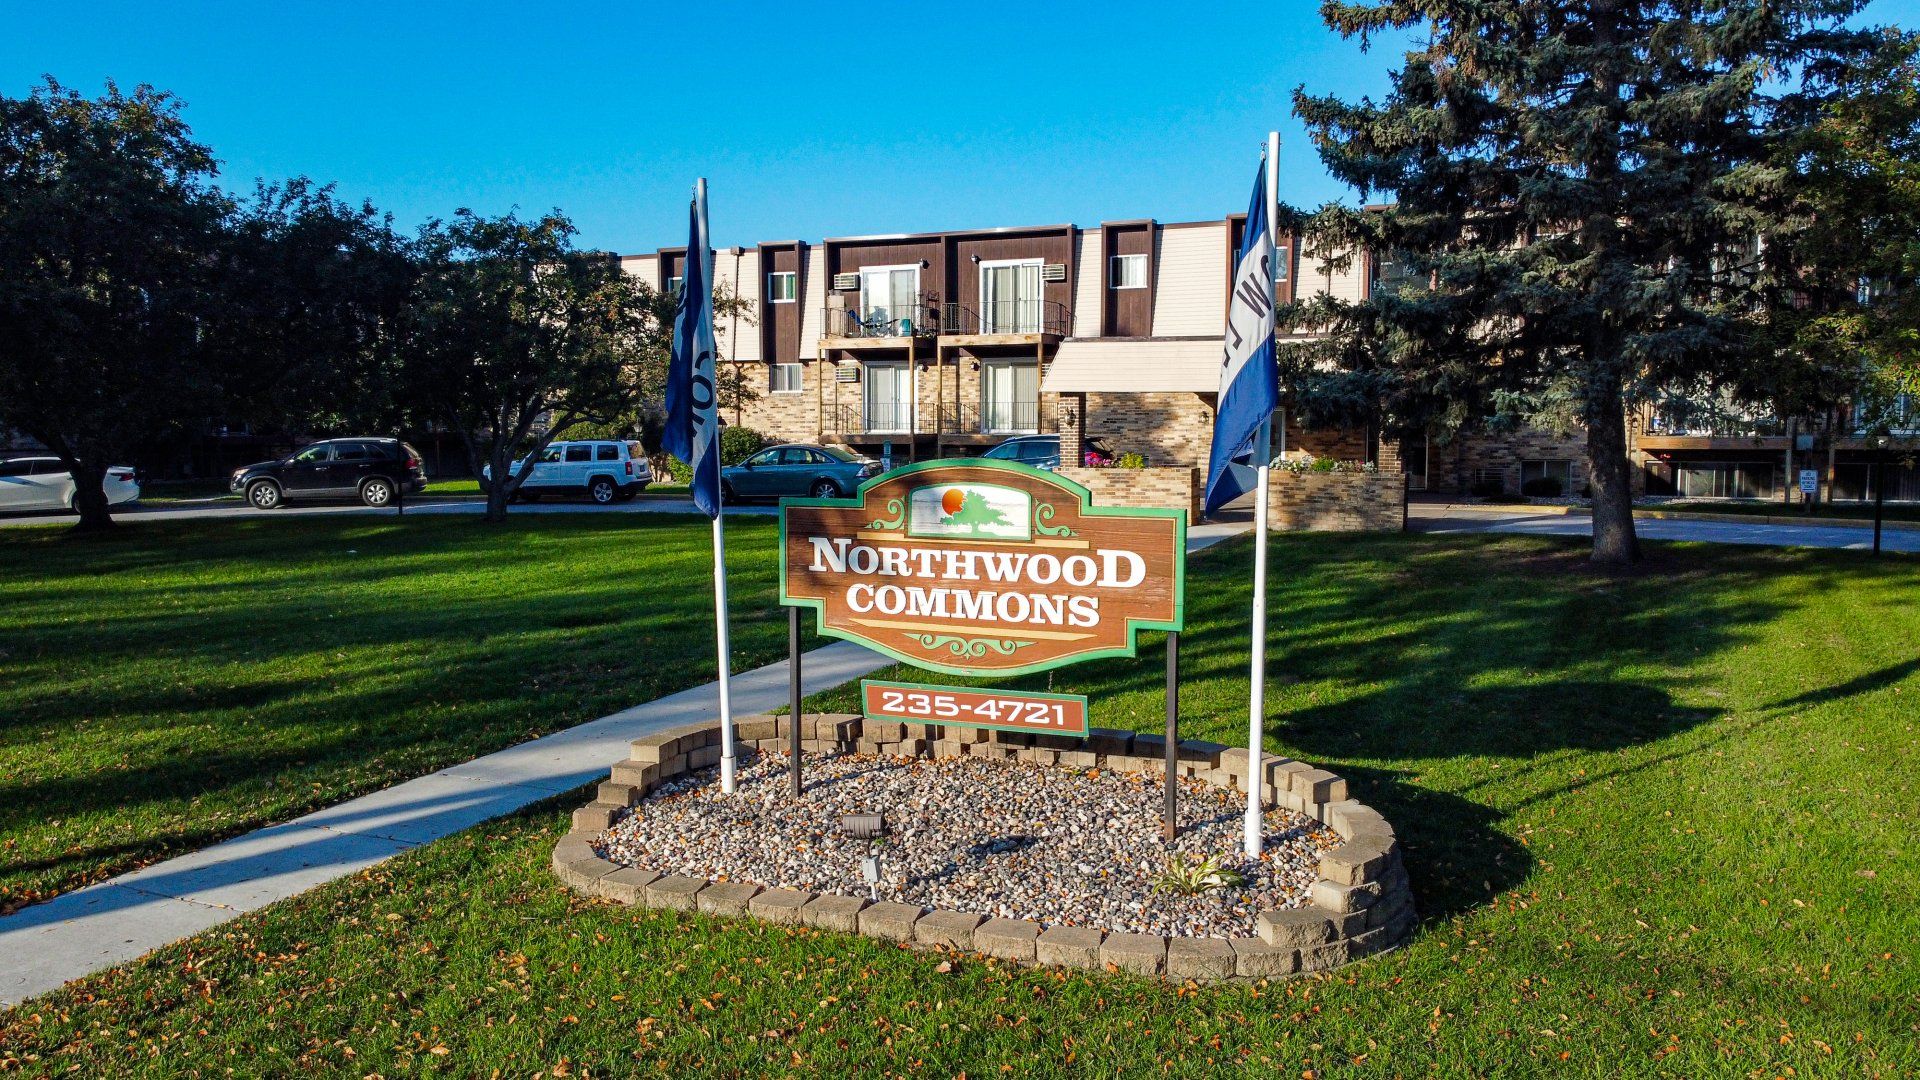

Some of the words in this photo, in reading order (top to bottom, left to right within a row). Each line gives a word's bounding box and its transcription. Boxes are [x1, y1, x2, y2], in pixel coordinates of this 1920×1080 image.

[808, 537, 1147, 588] NORTHWOOD
[846, 583, 1100, 627] COMMONS
[881, 691, 1065, 726] 235-4721
